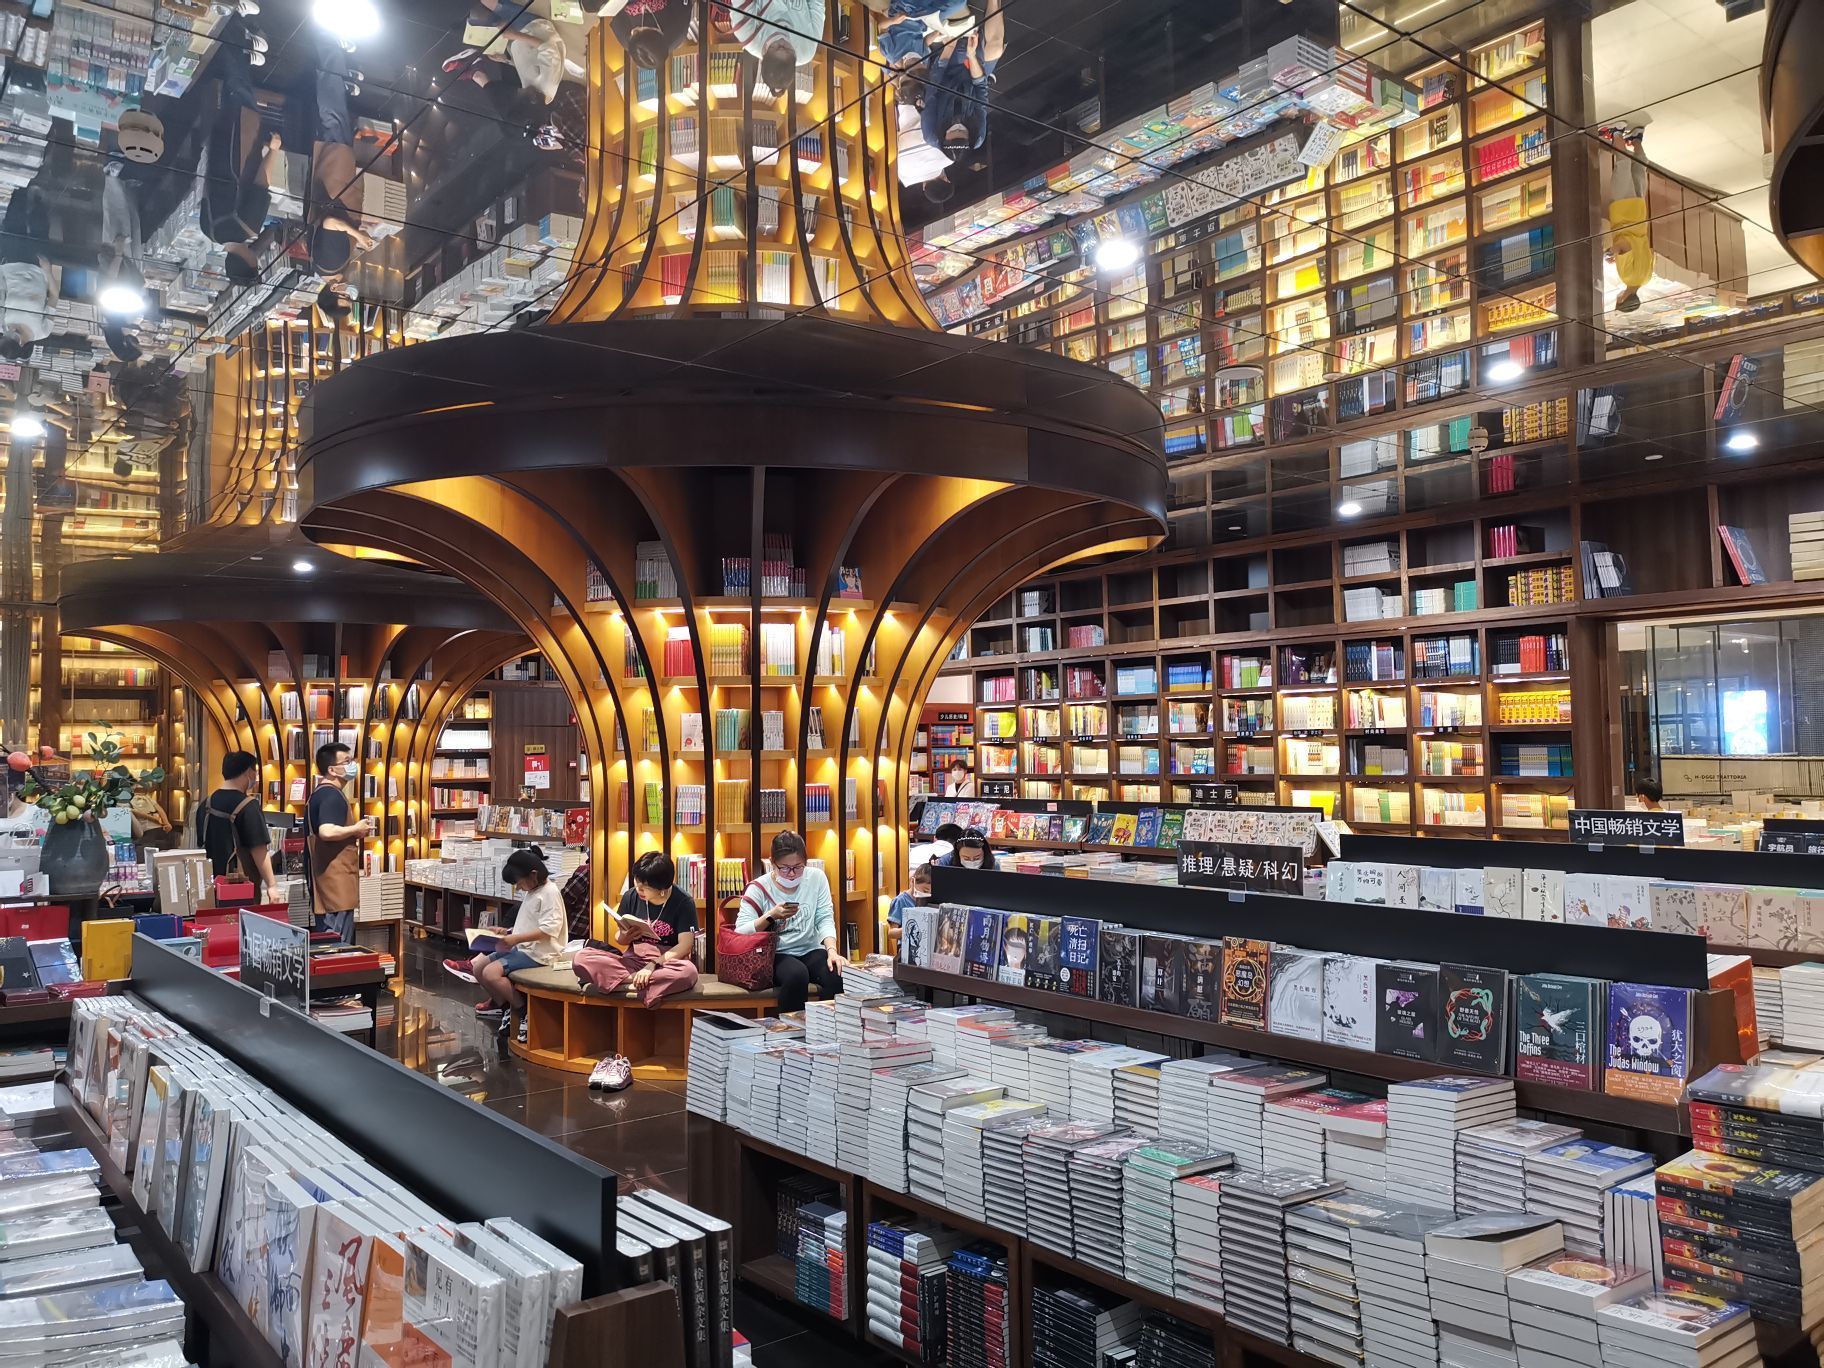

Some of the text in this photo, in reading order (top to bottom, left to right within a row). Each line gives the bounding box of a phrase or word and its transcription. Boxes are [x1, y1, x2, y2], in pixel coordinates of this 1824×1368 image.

[1195, 788, 1233, 799] 迪士尼
[1574, 817, 1681, 838] 中国畅销文学
[1182, 855, 1298, 882] 推理/悬疑/科幻
[1069, 924, 1088, 937] 死亡
[1069, 938, 1087, 951] 清扫
[243, 928, 305, 989] 中国畅销文学
[1069, 952, 1088, 964] 日记
[1519, 1030, 1550, 1045] The Three
[1575, 1021, 1586, 1065] 三口棺材
[1519, 1042, 1542, 1056] Coffins
[1609, 1044, 1621, 1056] The
[1671, 1029, 1683, 1077] 犹大之窗
[1608, 1056, 1659, 1073] Judas Window
